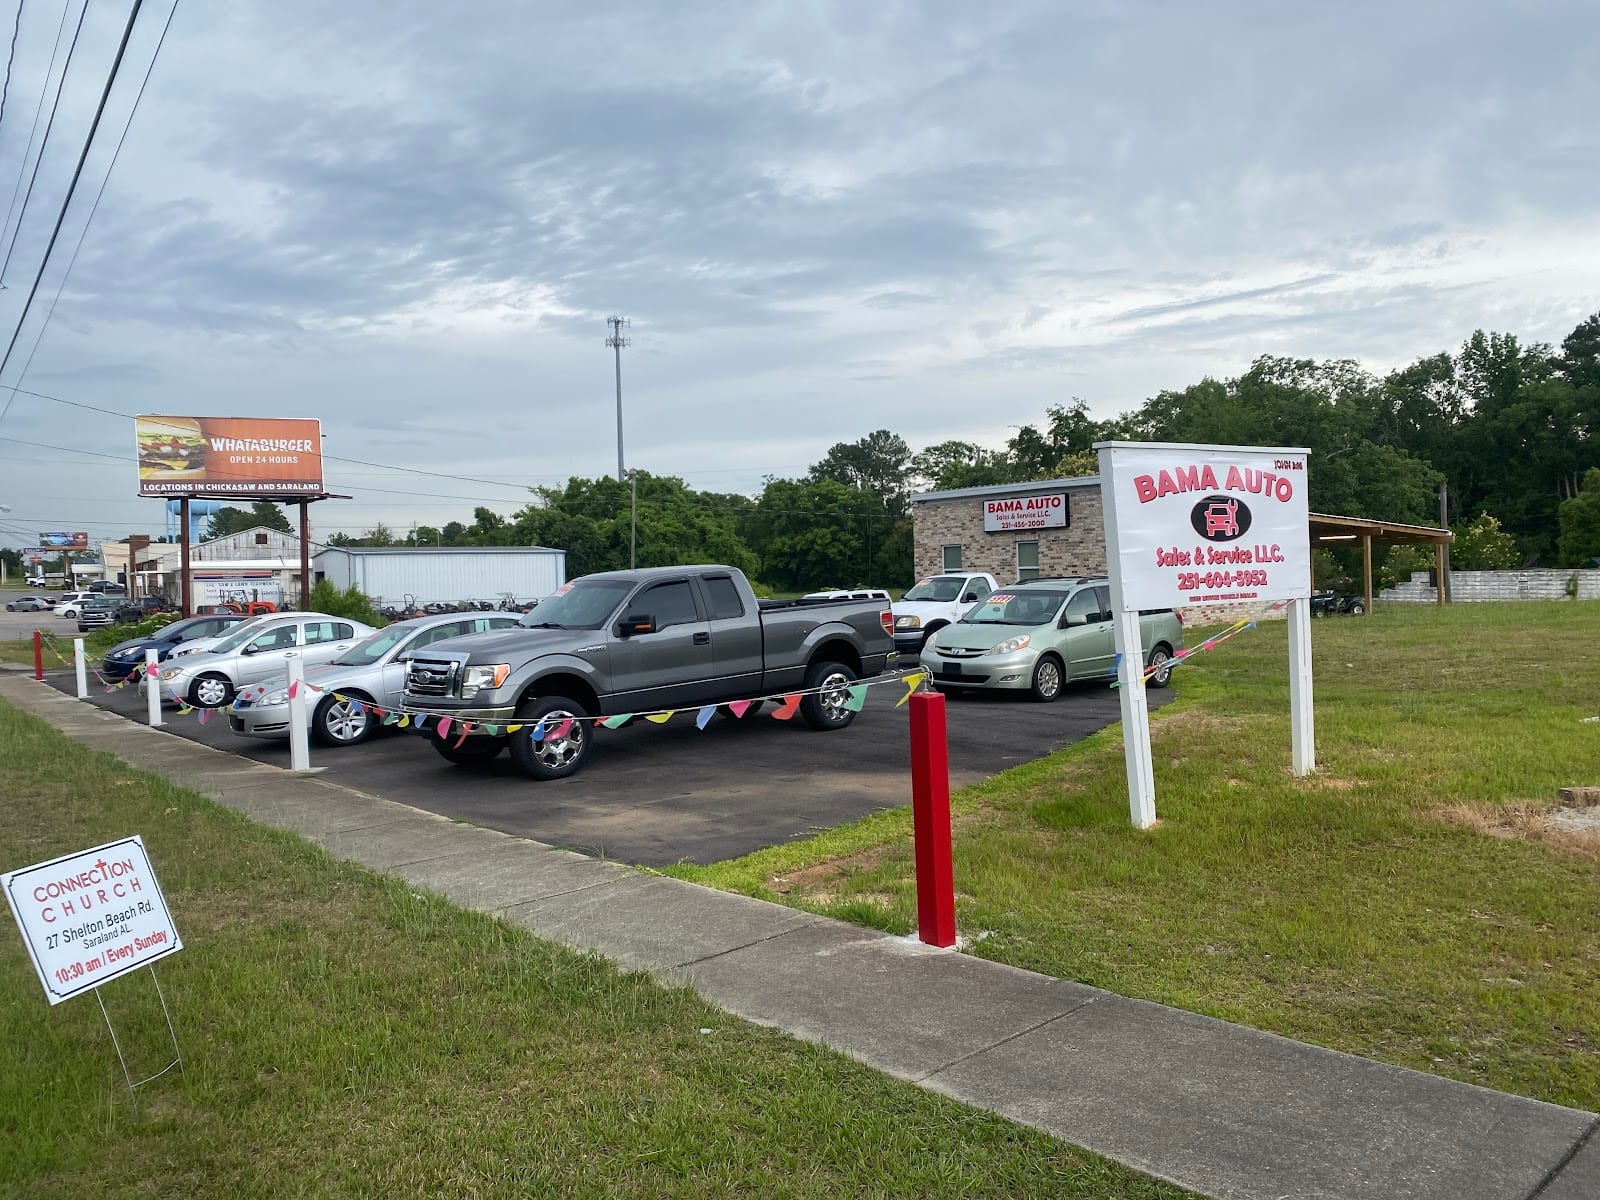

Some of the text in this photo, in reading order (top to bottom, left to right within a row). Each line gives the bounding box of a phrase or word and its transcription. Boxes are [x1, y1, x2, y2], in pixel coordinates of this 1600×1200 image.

[210, 438, 313, 452] WHATABURGER
[229, 455, 298, 464] OPEN 24 HOURS
[1274, 459, 1291, 470] JOHN
[143, 483, 193, 491] LOCATIONS
[194, 483, 205, 491] IN
[206, 483, 256, 491] CHICKASAW
[1133, 465, 1292, 503] BAMA AUTO
[988, 497, 1061, 513] BAMA AUTO
[1016, 511, 1036, 519] Service
[1001, 520, 1045, 528] 251-456-2000
[1156, 543, 1285, 567] Sales & Service LLC.
[1177, 569, 1268, 590] 251-604-5952
[33, 859, 134, 902] CONNECTION
[41, 877, 142, 923] CHURCH
[45, 899, 155, 950] 27 Shelton Beach Rd.
[83, 924, 133, 949] Saraland AL.
[55, 930, 168, 984] 10:30 am / Every Sunday
